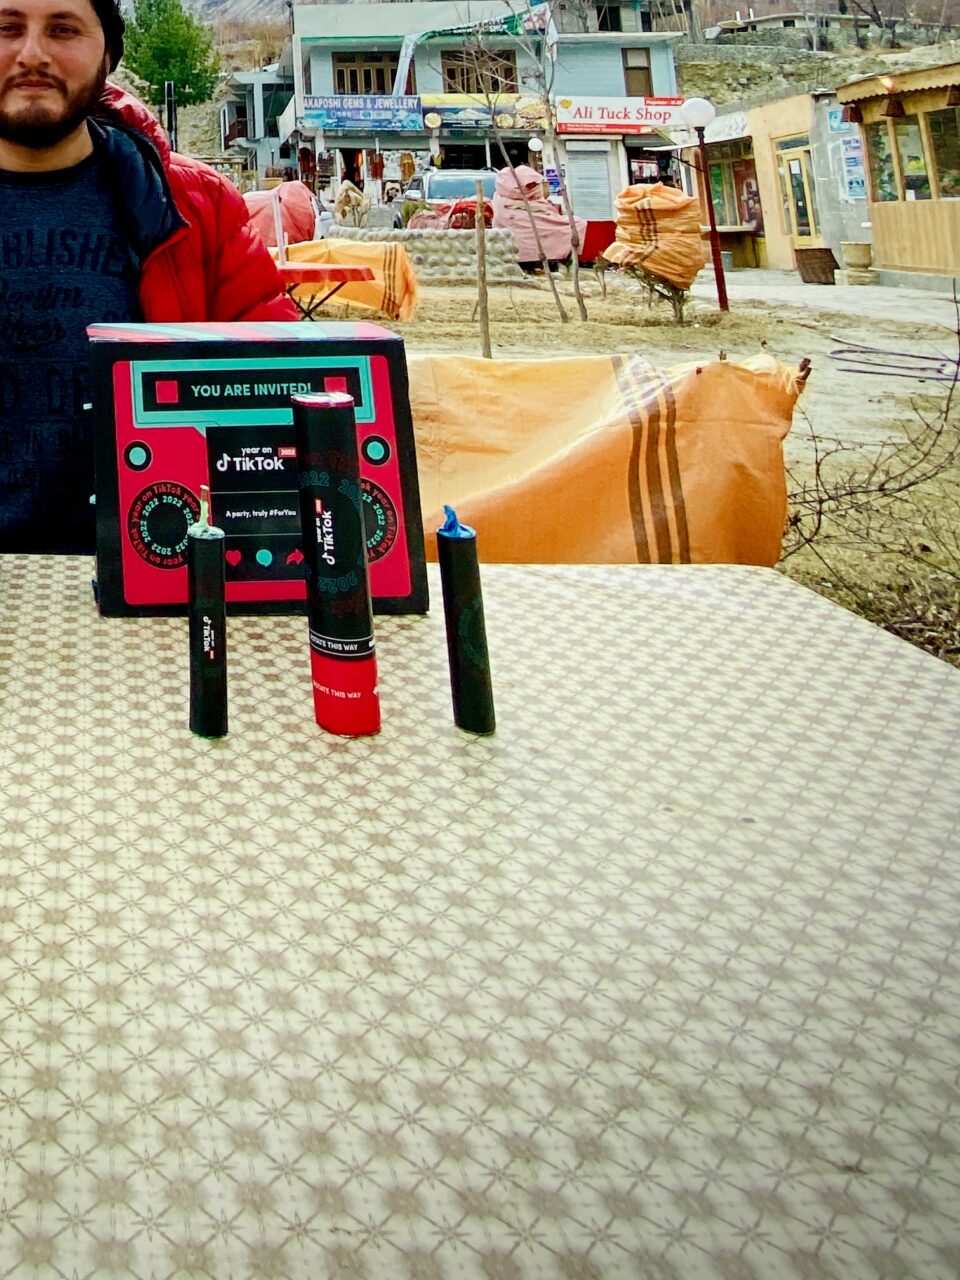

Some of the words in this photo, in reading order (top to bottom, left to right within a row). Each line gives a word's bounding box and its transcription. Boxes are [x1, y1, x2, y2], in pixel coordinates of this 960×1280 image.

[303, 98, 341, 109] AKAPOSHI
[343, 98, 364, 109] GEMS
[374, 98, 418, 109] JEWELLERY
[573, 106, 593, 119] Ali
[598, 107, 631, 120] Tuck
[636, 107, 672, 123] Shop
[191, 384, 220, 397] YOU
[224, 384, 250, 396] ARE
[254, 382, 311, 395] INVITED!
[241, 447, 260, 456] year
[233, 456, 284, 471] TikTok
[142, 491, 153, 501] on
[153, 484, 182, 495] TikTok
[362, 493, 372, 503] 22
[142, 498, 160, 517] 2022
[162, 495, 183, 508] 2022
[183, 507, 194, 526] 202
[232, 510, 251, 519] party,
[252, 509, 268, 518] truly
[269, 508, 296, 517] #ForYou
[373, 503, 385, 526] 2022
[140, 520, 152, 543] 2022
[322, 510, 334, 551] TikTok
[151, 543, 172, 556] 2022
[203, 626, 211, 652] TikTok
[327, 641, 342, 650] THIS
[330, 689, 346, 699] THIS
